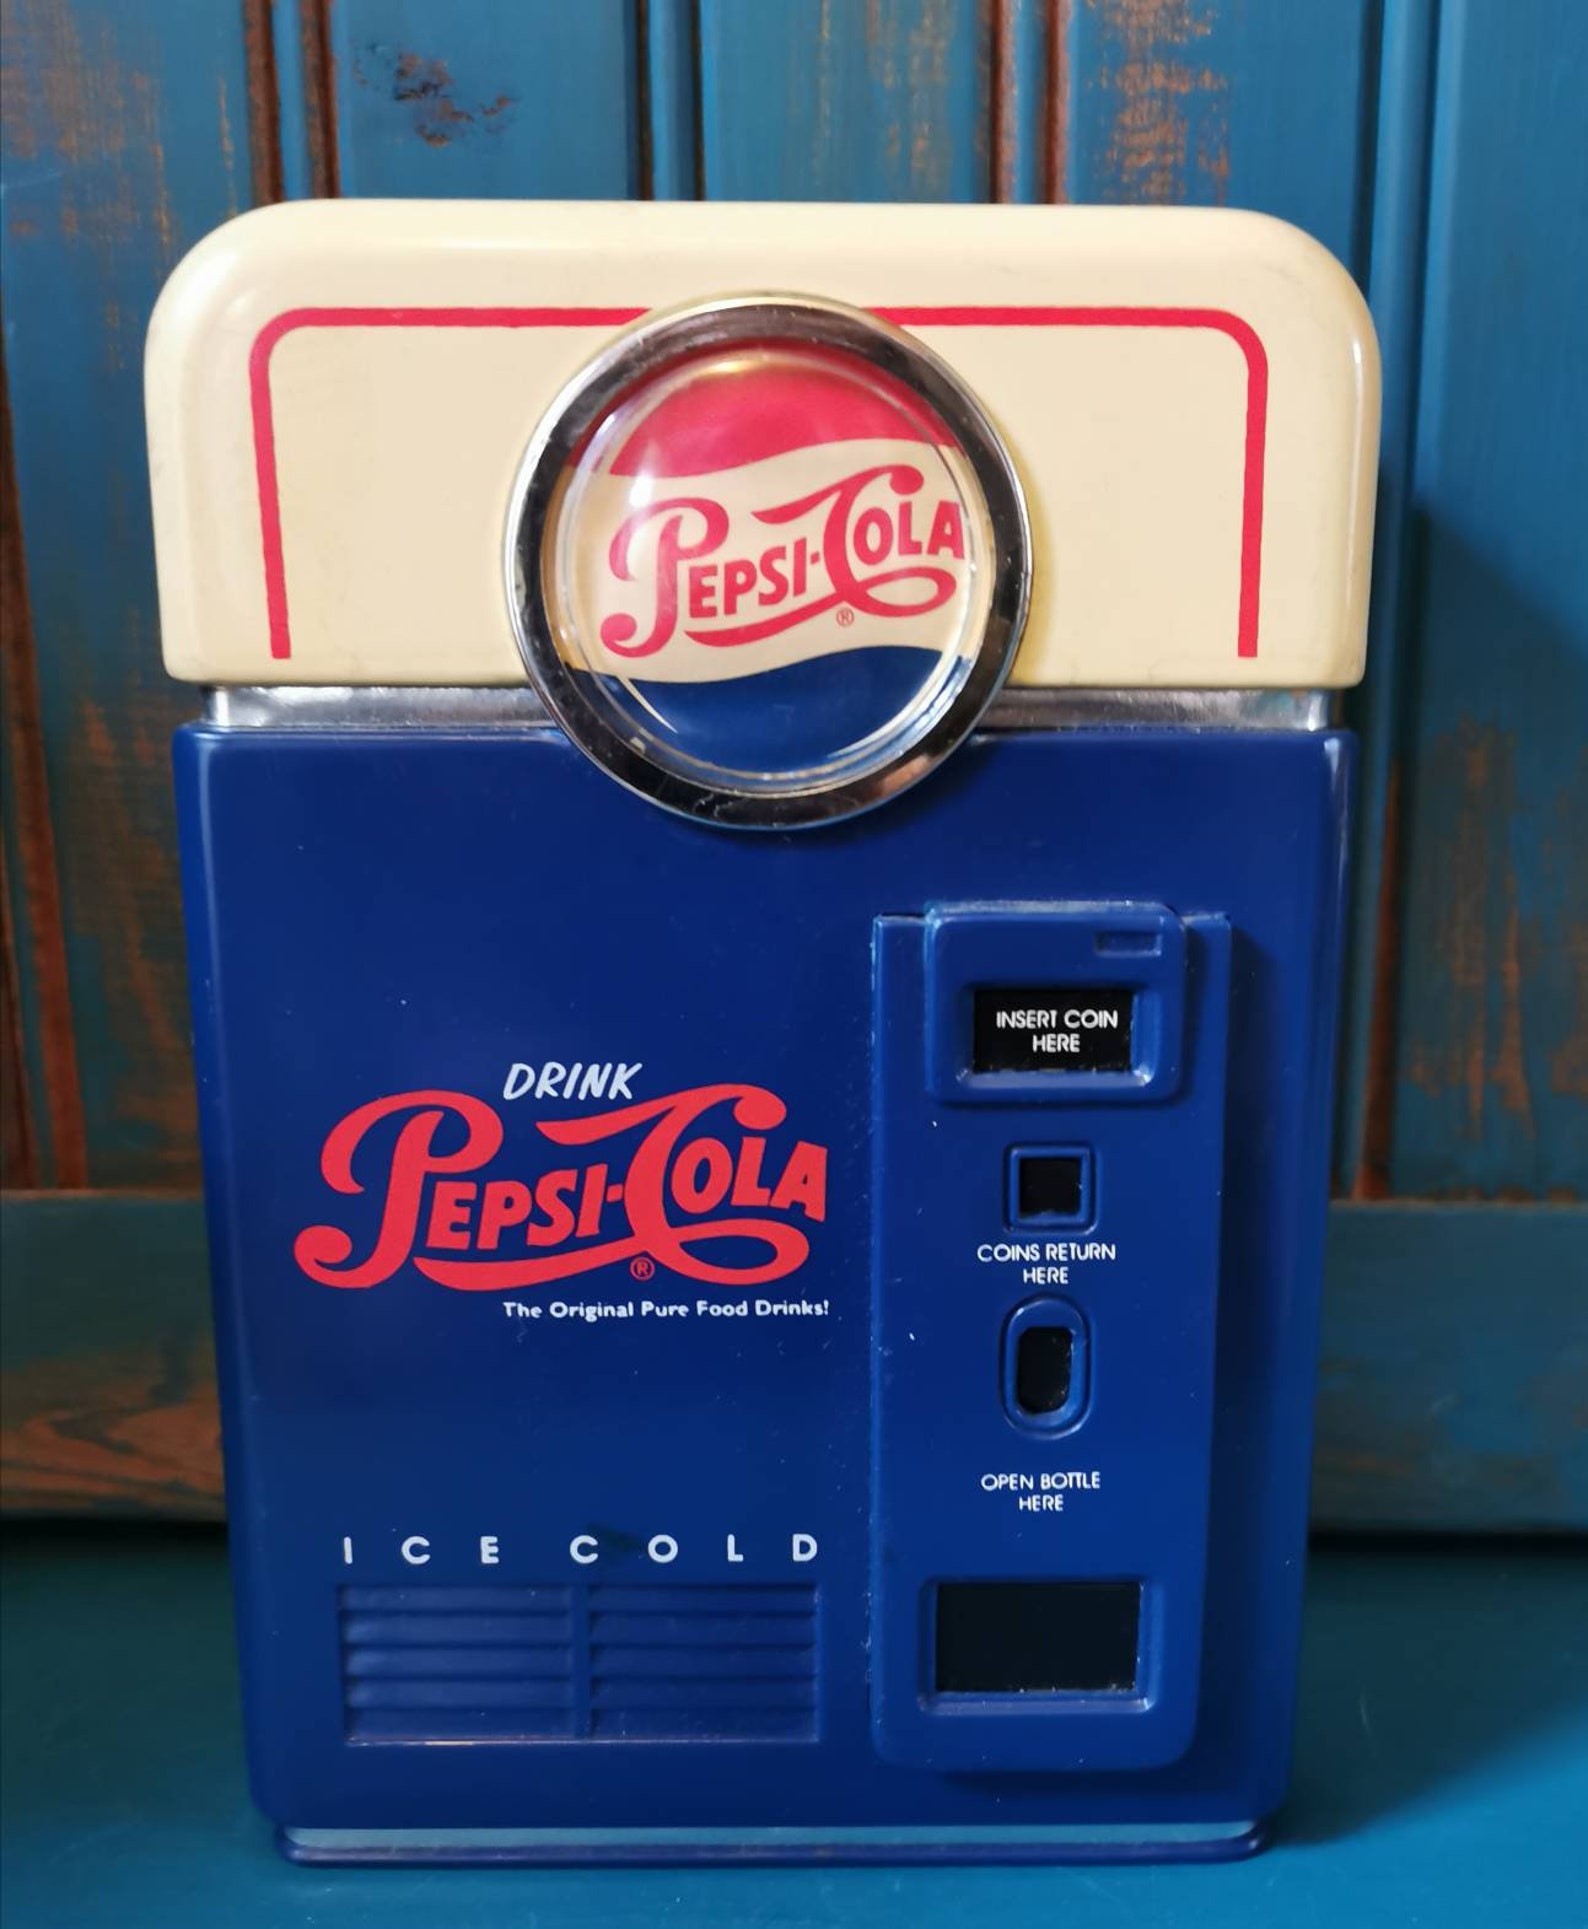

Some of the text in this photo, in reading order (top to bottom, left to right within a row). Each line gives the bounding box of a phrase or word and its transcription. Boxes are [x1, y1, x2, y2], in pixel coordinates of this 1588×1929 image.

[600, 464, 965, 658] PEPSI-COLA
[996, 1009, 1118, 1029] INSERT COIN
[1032, 1033, 1080, 1053] HERE
[503, 1062, 643, 1100] DRINK
[294, 1083, 827, 1291] PEPSI-COLA
[977, 1242, 1116, 1262] COINS RETURN
[1022, 1266, 1069, 1285] HERE
[503, 1299, 829, 1322] The Original Pure Food Drinks!
[980, 1471, 1101, 1491] OPEN BOTTLE
[1018, 1494, 1064, 1512] HERE
[343, 1533, 818, 1565] ICE COLD
